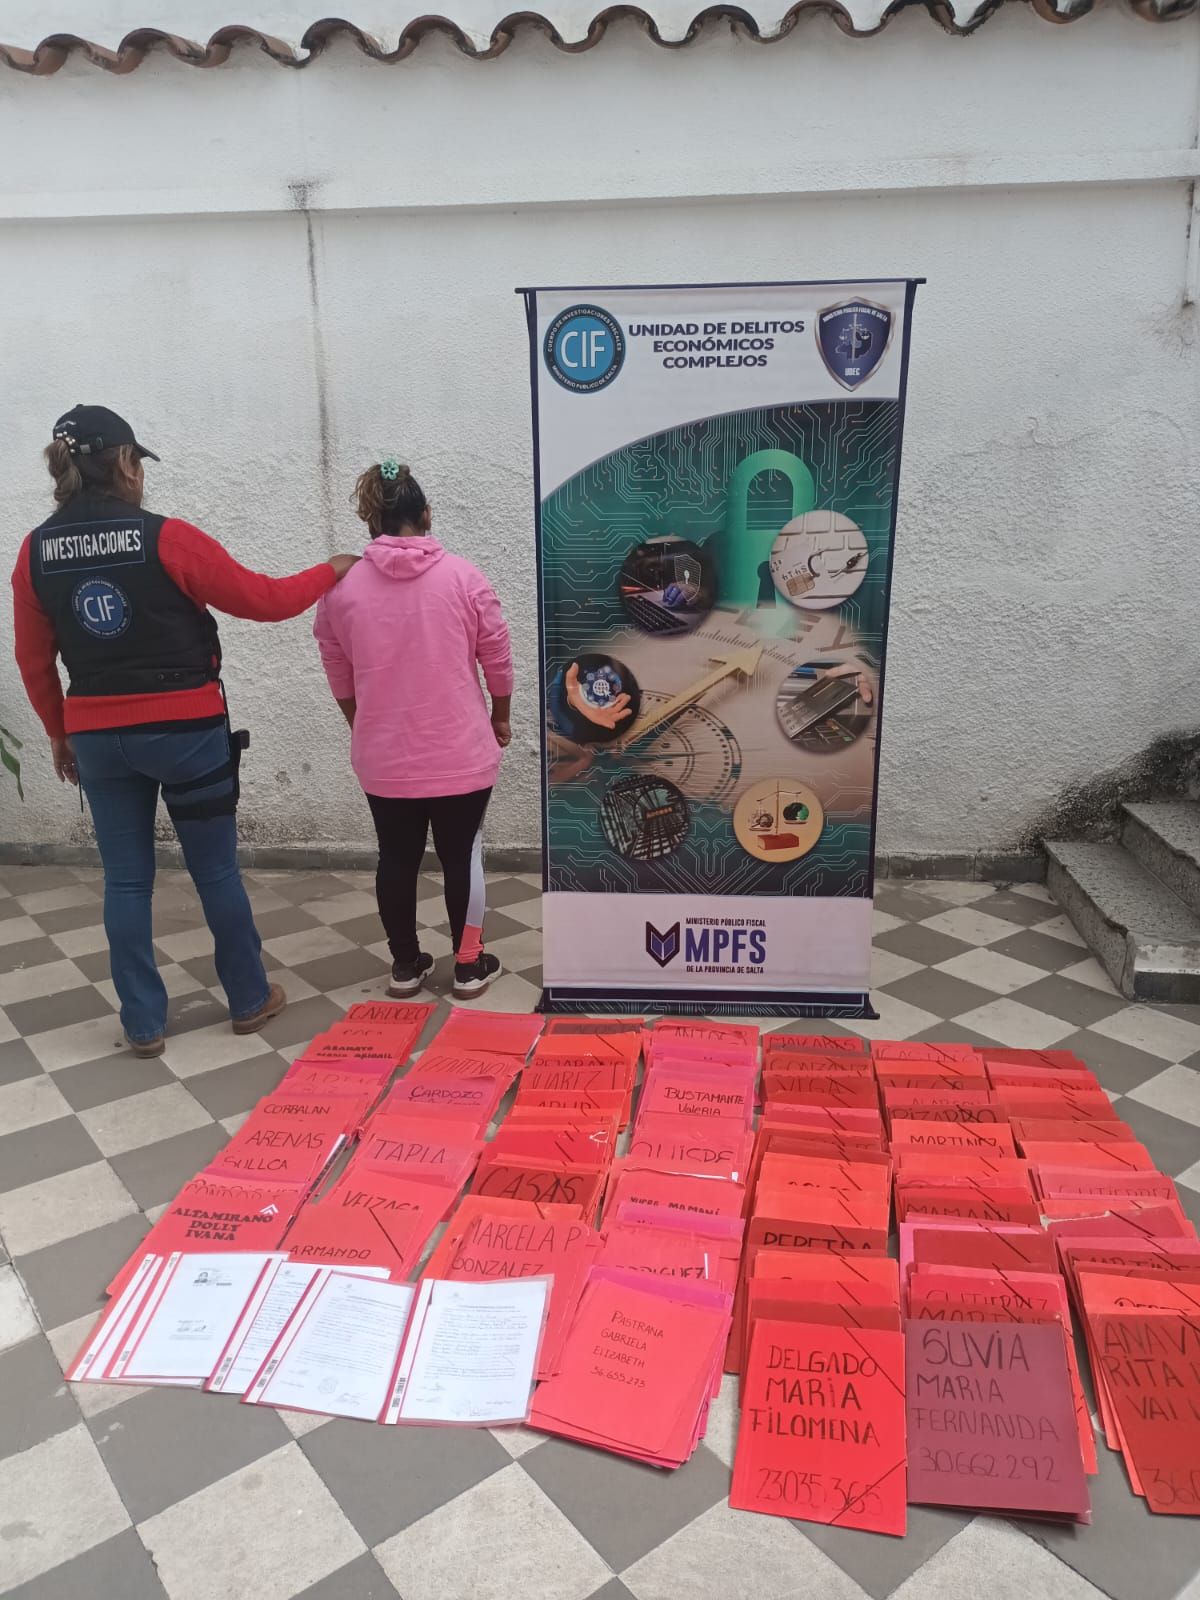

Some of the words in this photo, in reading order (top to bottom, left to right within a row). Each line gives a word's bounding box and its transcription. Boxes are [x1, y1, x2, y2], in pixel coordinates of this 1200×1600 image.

[628, 323, 699, 337] UNIDAD
[703, 322, 727, 335] DE
[730, 320, 805, 335] DELITOS
[560, 330, 606, 368] CIF
[653, 336, 775, 353] ECONÓMICOS
[662, 354, 768, 369] COMPLEJOS
[42, 529, 142, 562] INVESTIGACIONES
[83, 594, 115, 623] CIF
[685, 917, 719, 926] MINISTERIO
[745, 919, 767, 928] FISCAL
[685, 927, 767, 964] MPFS
[686, 965, 694, 973] DE
[695, 965, 703, 973] LA
[704, 965, 736, 974] PROVINCIA
[736, 966, 744, 974] DE
[745, 966, 764, 974] SALTA
[263, 1103, 330, 1115] CORBALAN
[244, 1130, 326, 1149] ARENAS
[373, 1138, 447, 1164] TAPIA
[477, 1166, 585, 1203] CASAS
[172, 1207, 274, 1223] ALTAMIRANO
[189, 1220, 242, 1232] DOLLY
[184, 1229, 236, 1241] IVANA
[289, 1245, 372, 1260] ARMANDO
[611, 1310, 664, 1338] PASTRANA
[600, 1327, 647, 1352] GABRIELA
[592, 1345, 646, 1369] ELIZABETH
[766, 1344, 879, 1378] DELGADO
[915, 1373, 1005, 1404] MARIA
[911, 1406, 1061, 1443] FERNANDA
